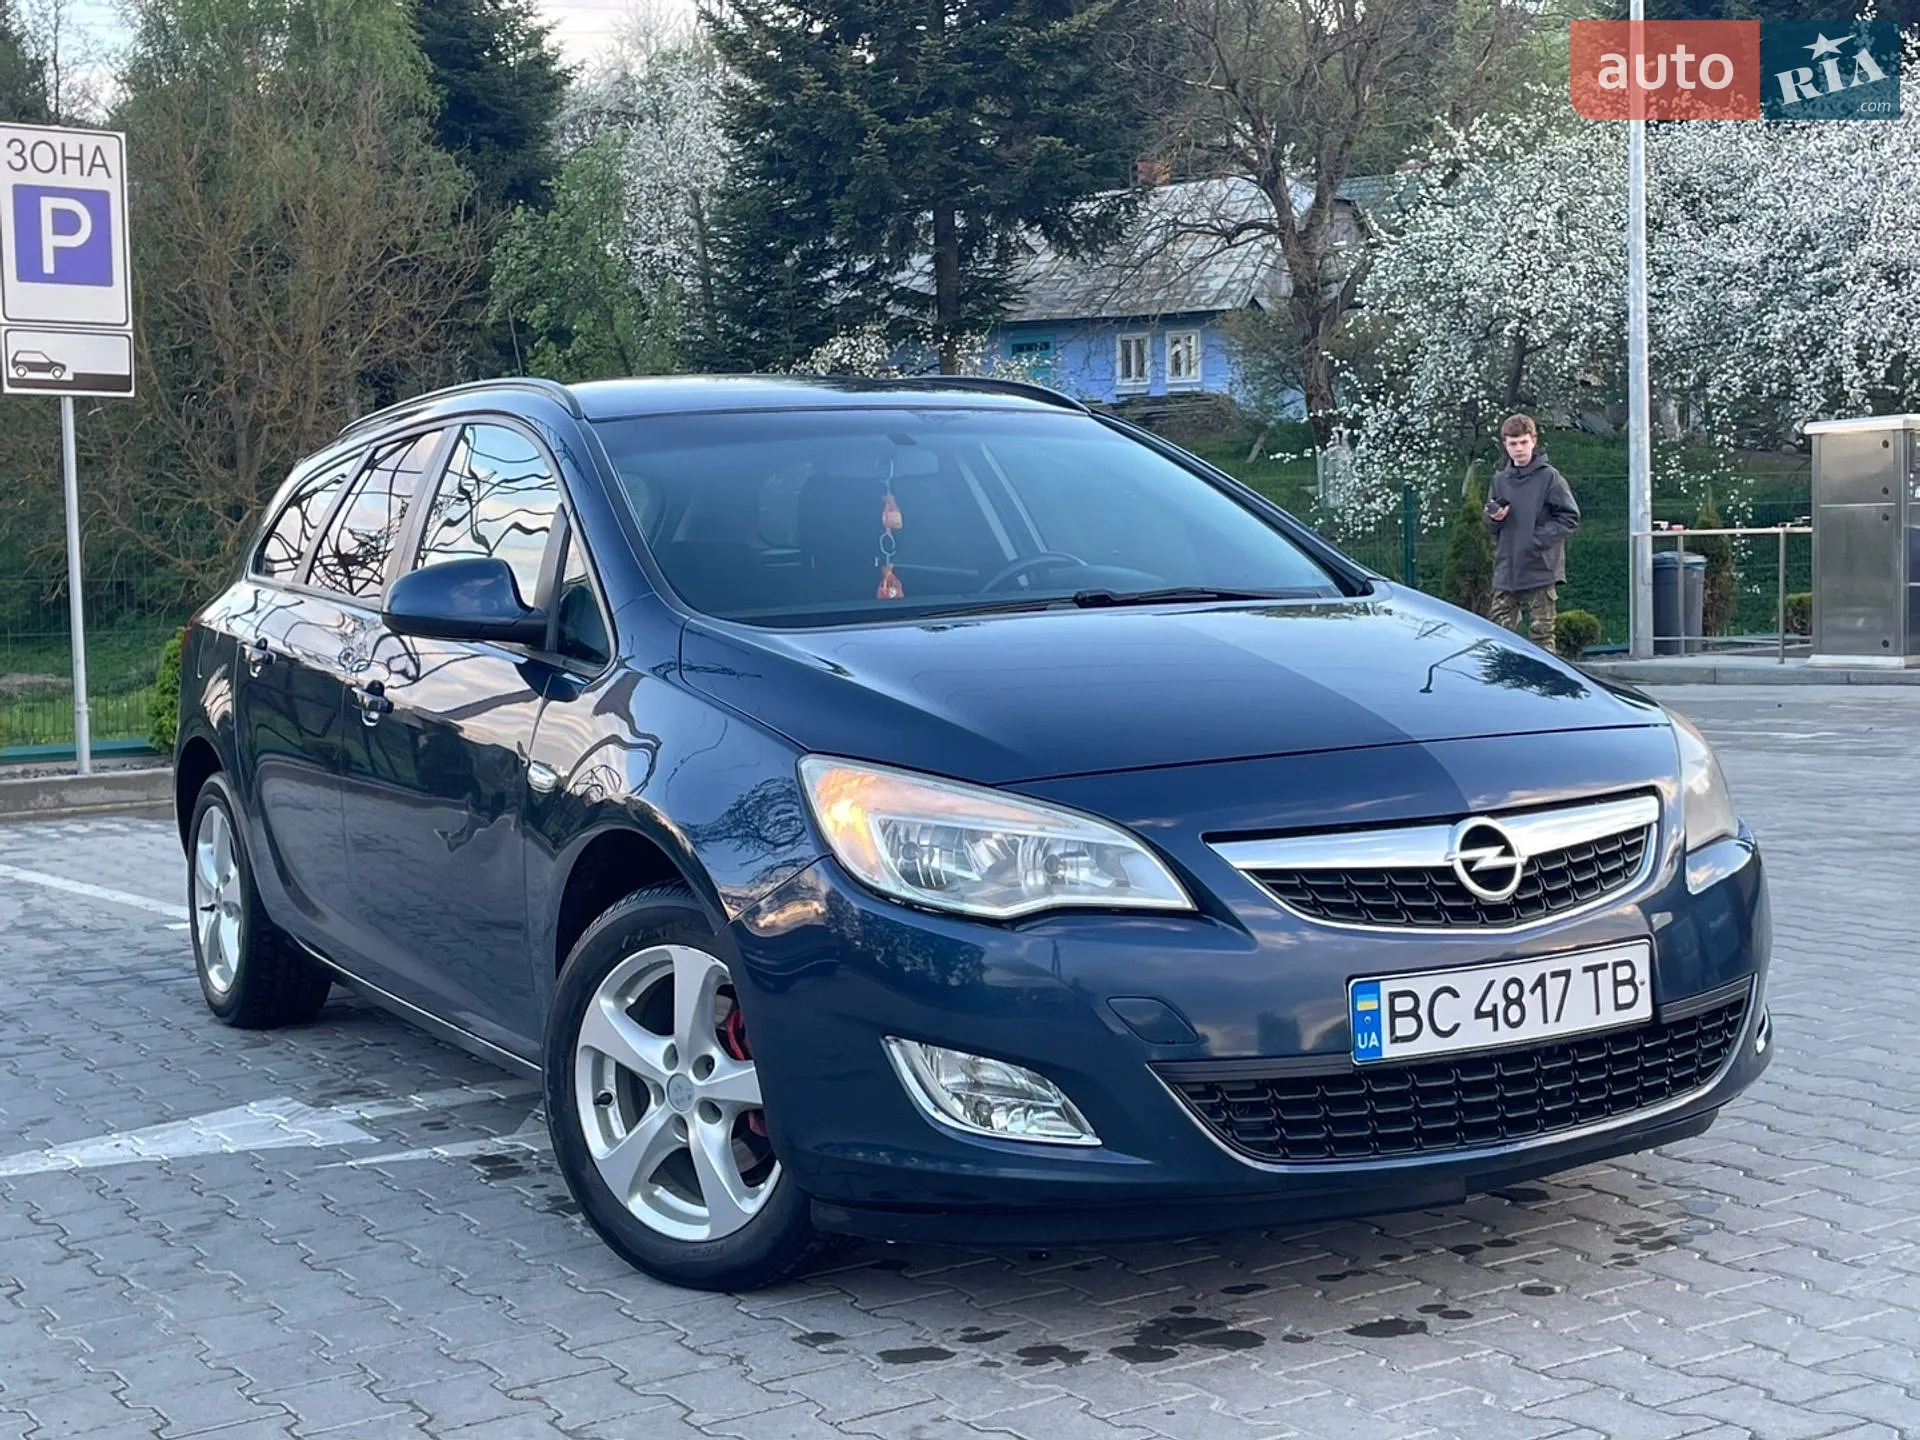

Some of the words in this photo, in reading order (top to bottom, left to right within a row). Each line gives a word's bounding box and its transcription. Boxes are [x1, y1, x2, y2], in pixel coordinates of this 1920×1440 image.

[6, 138, 112, 178] ЗОНА
[40, 196, 92, 275] P
[1388, 985, 1462, 1045] BC
[1474, 968, 1572, 1032] 4817
[1582, 959, 1640, 1016] TB
[1357, 1031, 1380, 1050] UA
